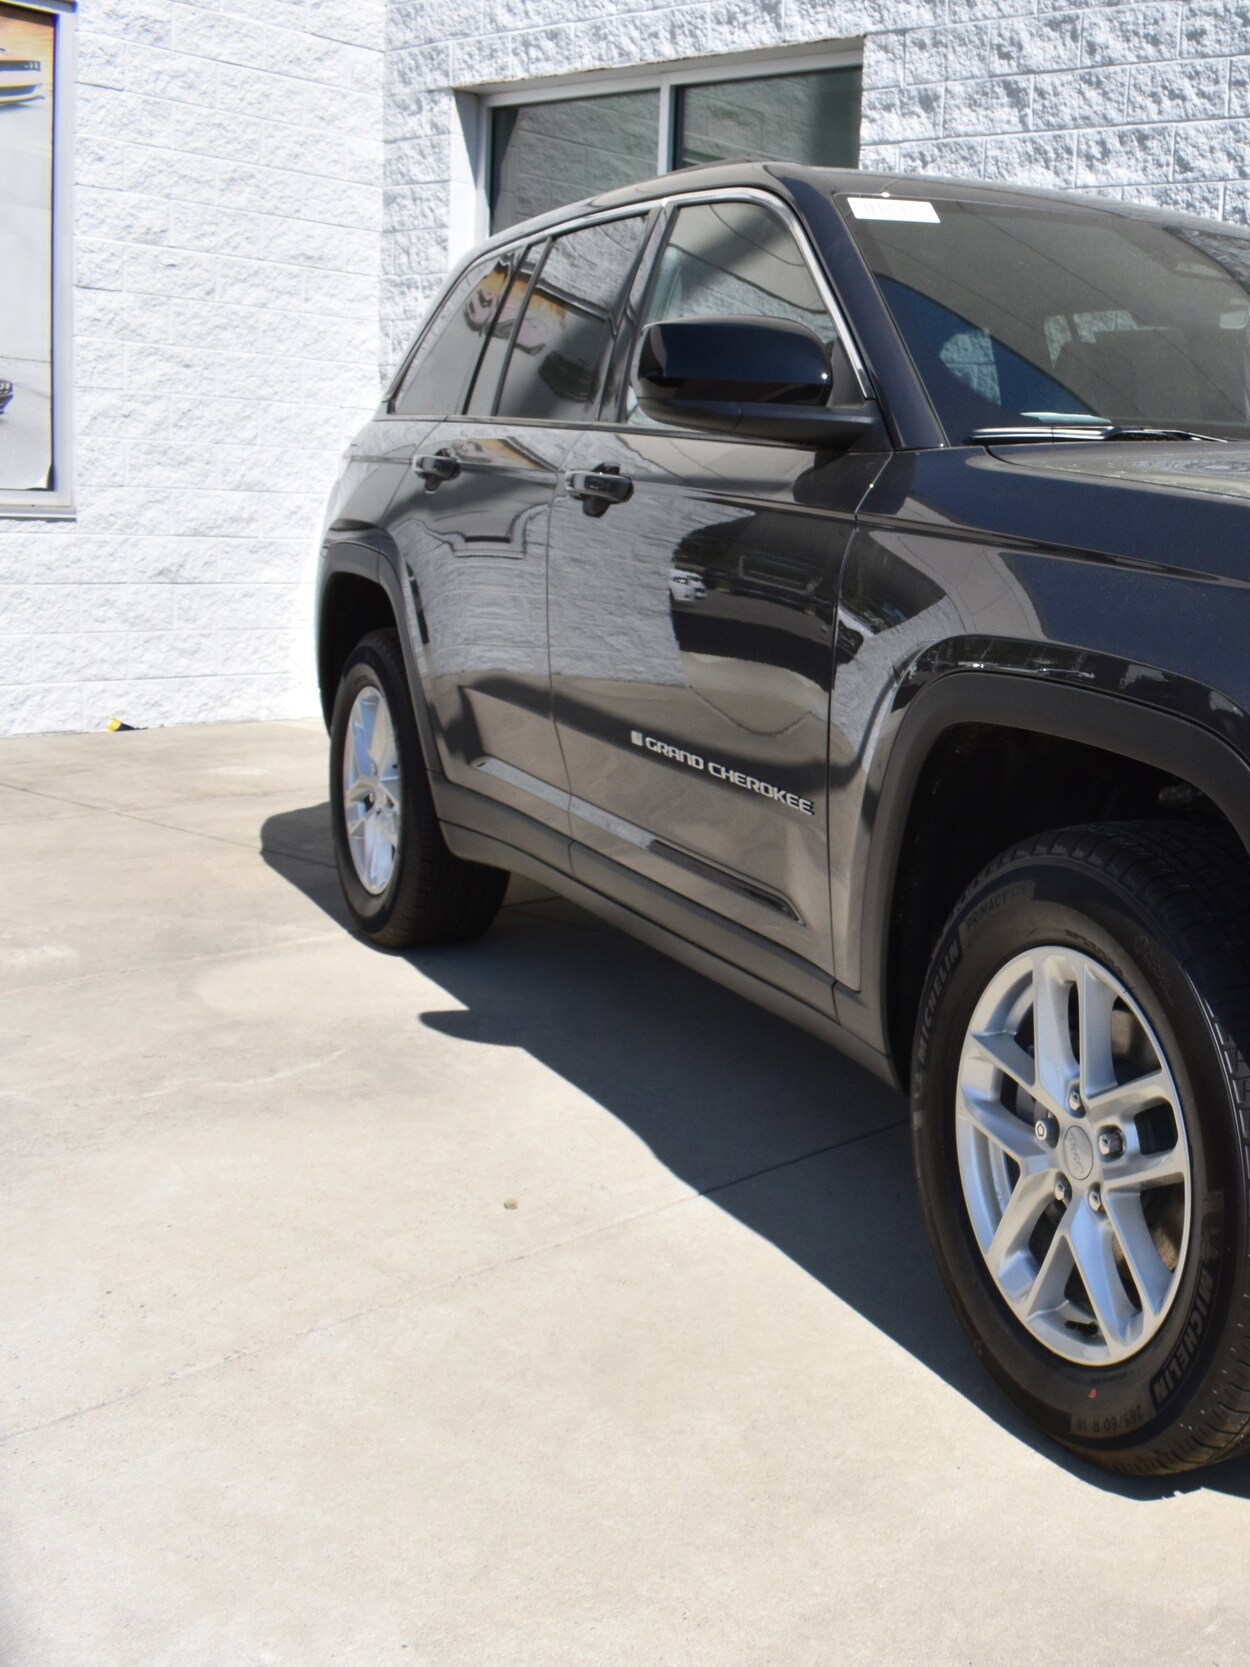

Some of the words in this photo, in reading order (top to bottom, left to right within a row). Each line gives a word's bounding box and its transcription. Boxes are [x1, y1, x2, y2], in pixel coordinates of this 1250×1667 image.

[645, 736, 705, 770] GRAND
[707, 760, 814, 815] CHEROKEE
[917, 938, 960, 1065] MICHELIN
[1154, 1267, 1214, 1403] MICHELIN
